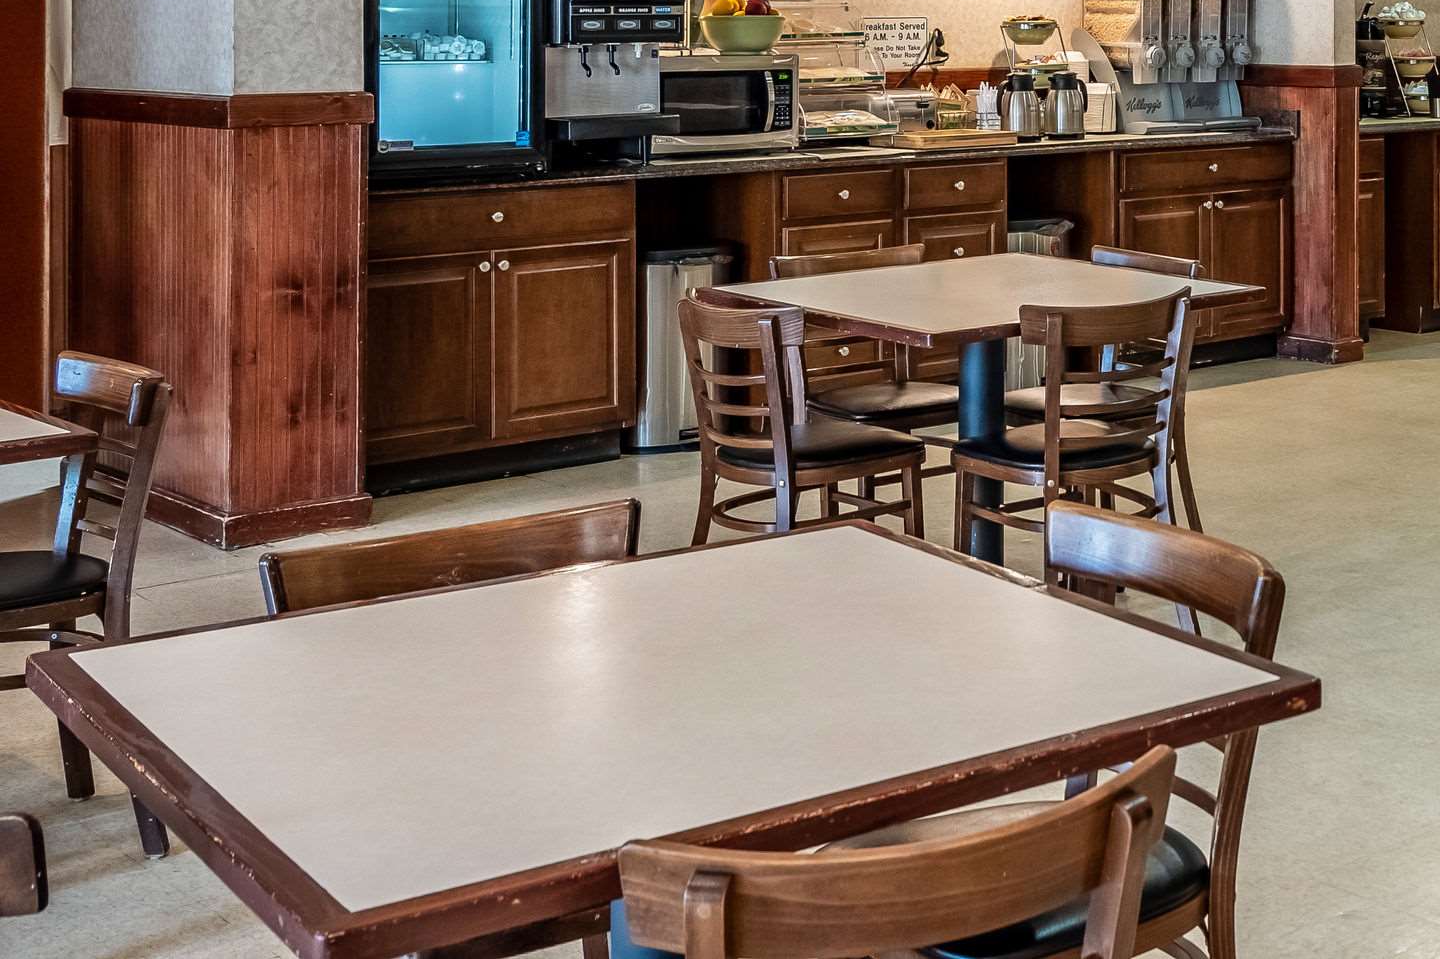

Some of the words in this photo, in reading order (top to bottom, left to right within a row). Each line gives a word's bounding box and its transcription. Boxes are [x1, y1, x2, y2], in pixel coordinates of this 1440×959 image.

[865, 23, 897, 31] reakfast
[899, 22, 925, 31] Served
[898, 32, 904, 40] 9
[1126, 97, 1162, 115] Kellogg's
